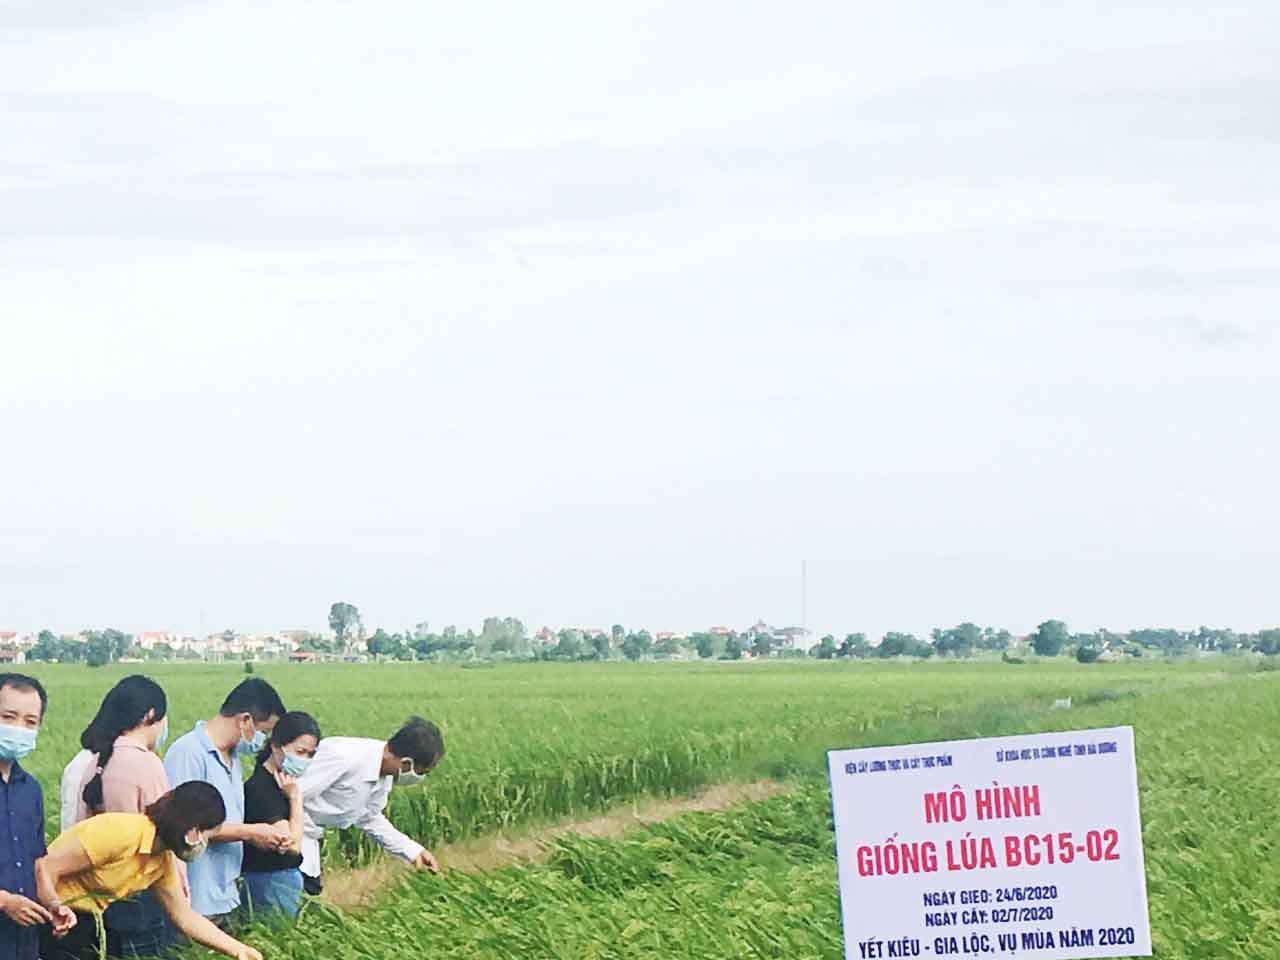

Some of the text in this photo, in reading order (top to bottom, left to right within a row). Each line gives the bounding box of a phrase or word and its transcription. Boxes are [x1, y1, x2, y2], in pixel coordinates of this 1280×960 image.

[923, 780, 1041, 824] MÔ HÌNH
[856, 828, 1121, 877] GIỐNG LÚA BC15-02
[960, 889, 993, 905] GIEO:
[996, 885, 1058, 903] 24/6/2020
[991, 906, 1054, 923] 02/7/2020
[858, 935, 883, 959] YẾT
[934, 936, 959, 955] GIA
[998, 933, 1017, 955] VỤ
[1021, 927, 1056, 950] MÙA
[1059, 926, 1094, 948] NĂM
[1098, 926, 1136, 946] 2020
